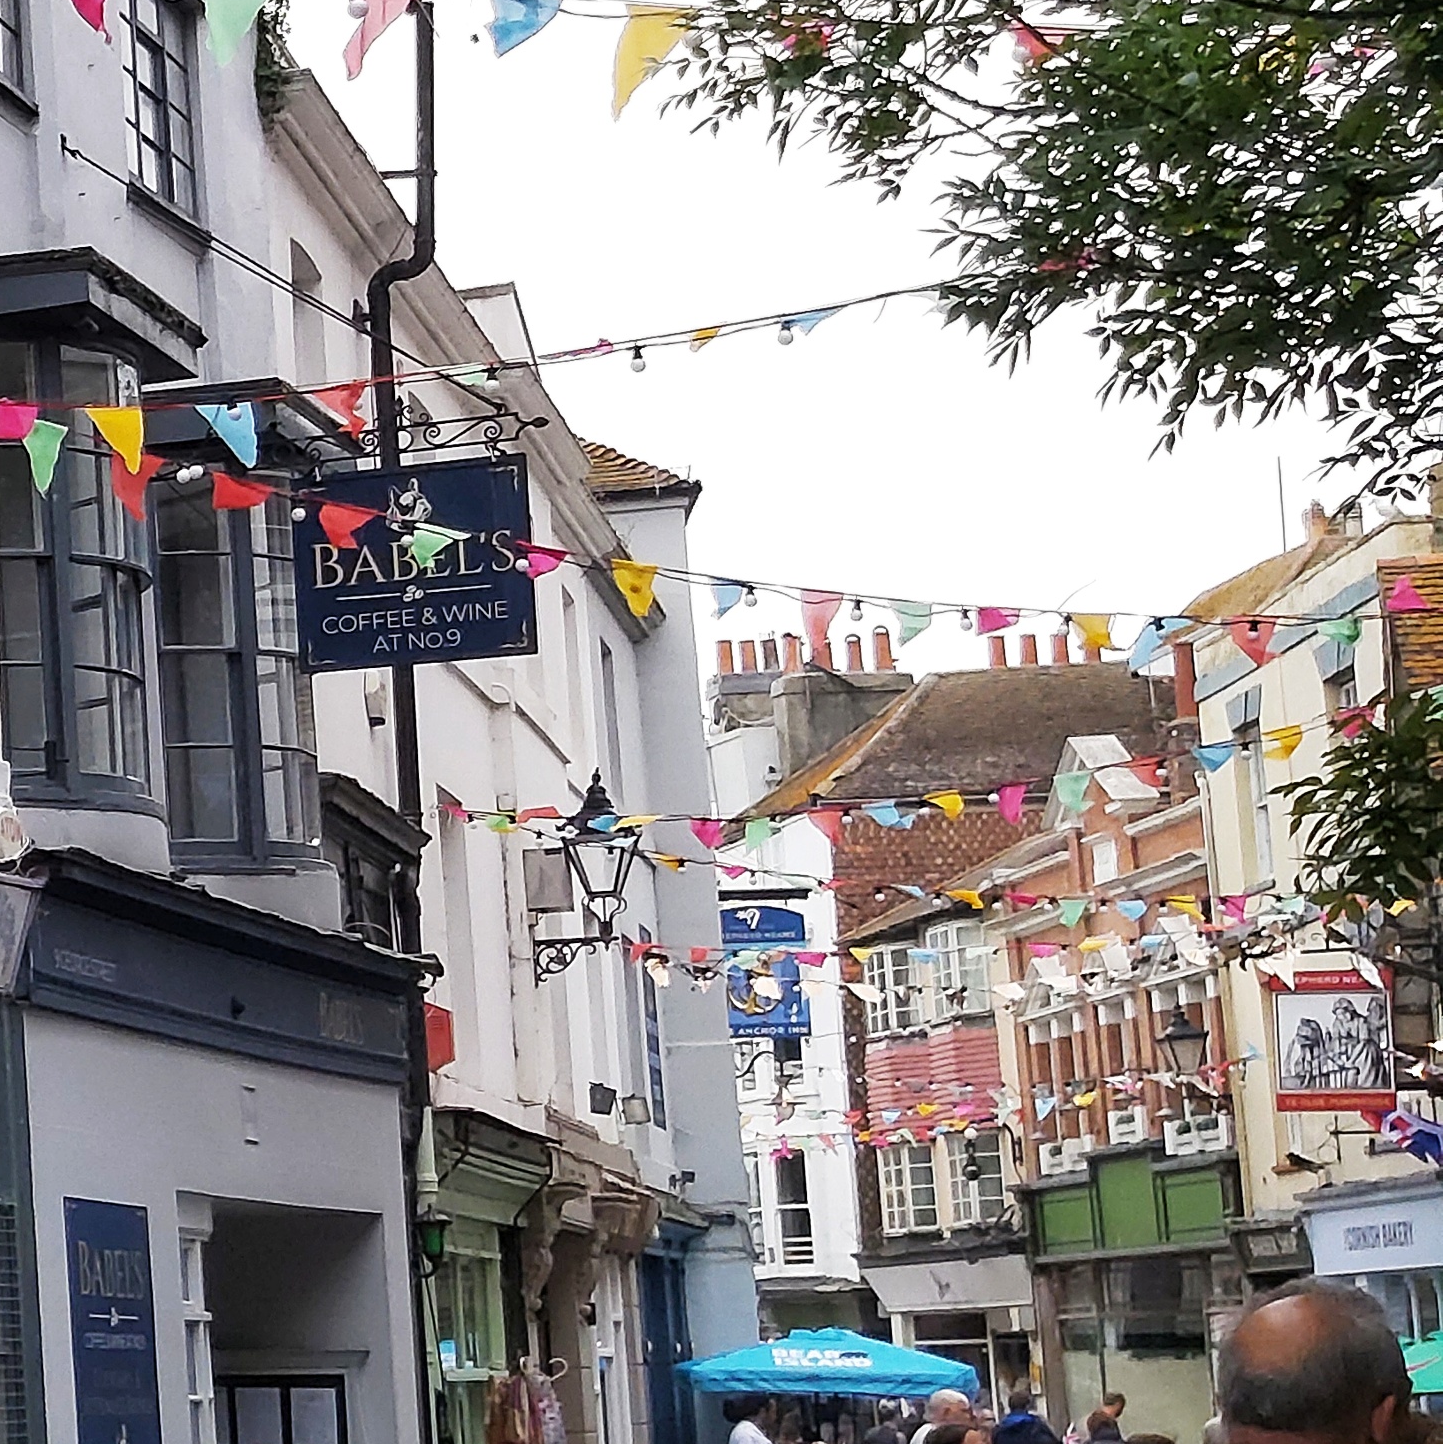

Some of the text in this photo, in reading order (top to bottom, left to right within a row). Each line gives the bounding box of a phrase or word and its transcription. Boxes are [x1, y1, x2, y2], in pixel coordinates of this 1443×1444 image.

[322, 600, 510, 635] COFFEE & WINE
[372, 634, 403, 654] AT
[737, 1026, 785, 1036] ANCHOR
[1382, 1220, 1414, 1248] BAKERY
[771, 1347, 841, 1359] BEAR
[773, 1357, 874, 1368] ISLAND
